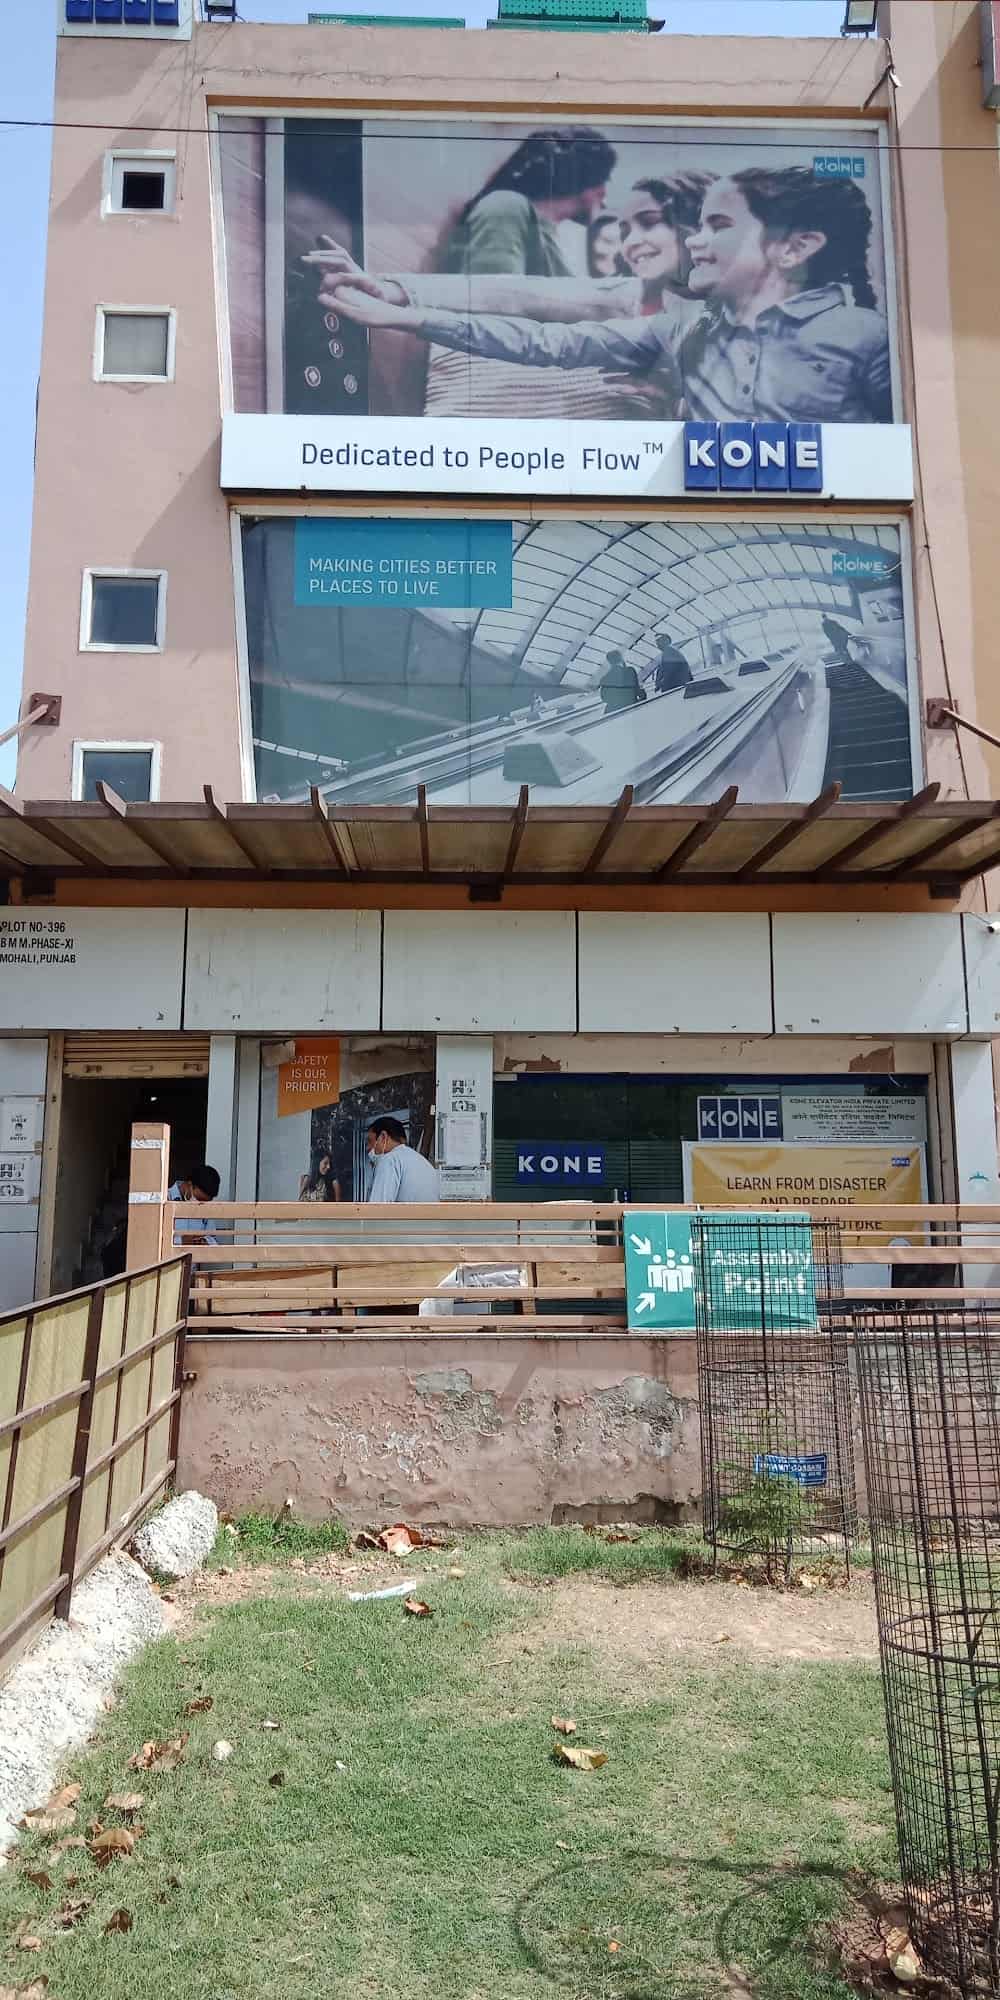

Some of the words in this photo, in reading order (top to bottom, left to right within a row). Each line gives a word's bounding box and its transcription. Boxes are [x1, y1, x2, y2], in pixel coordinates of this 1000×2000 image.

[815, 162, 863, 173] KONE
[302, 443, 434, 467] Dedicated
[444, 447, 469, 467] to
[479, 447, 565, 475] People
[689, 440, 819, 468] KONE
[309, 558, 373, 573] MAKING
[379, 560, 430, 574] CITIES
[436, 560, 497, 575] BETTER
[309, 579, 373, 593] PLACES
[378, 580, 398, 593] TO
[404, 581, 440, 594] LIVE
[292, 1069, 301, 1078] IS
[305, 1069, 326, 1078] OUR
[286, 1082, 331, 1092] PRIORITY
[701, 1110, 778, 1127] KONE
[518, 1155, 602, 1174] KONE
[727, 1177, 772, 1190] LEARN
[776, 1177, 815, 1190] FROM
[819, 1177, 887, 1191] DISASTER
[711, 1249, 812, 1270] Assembly
[723, 1272, 807, 1294] Point
